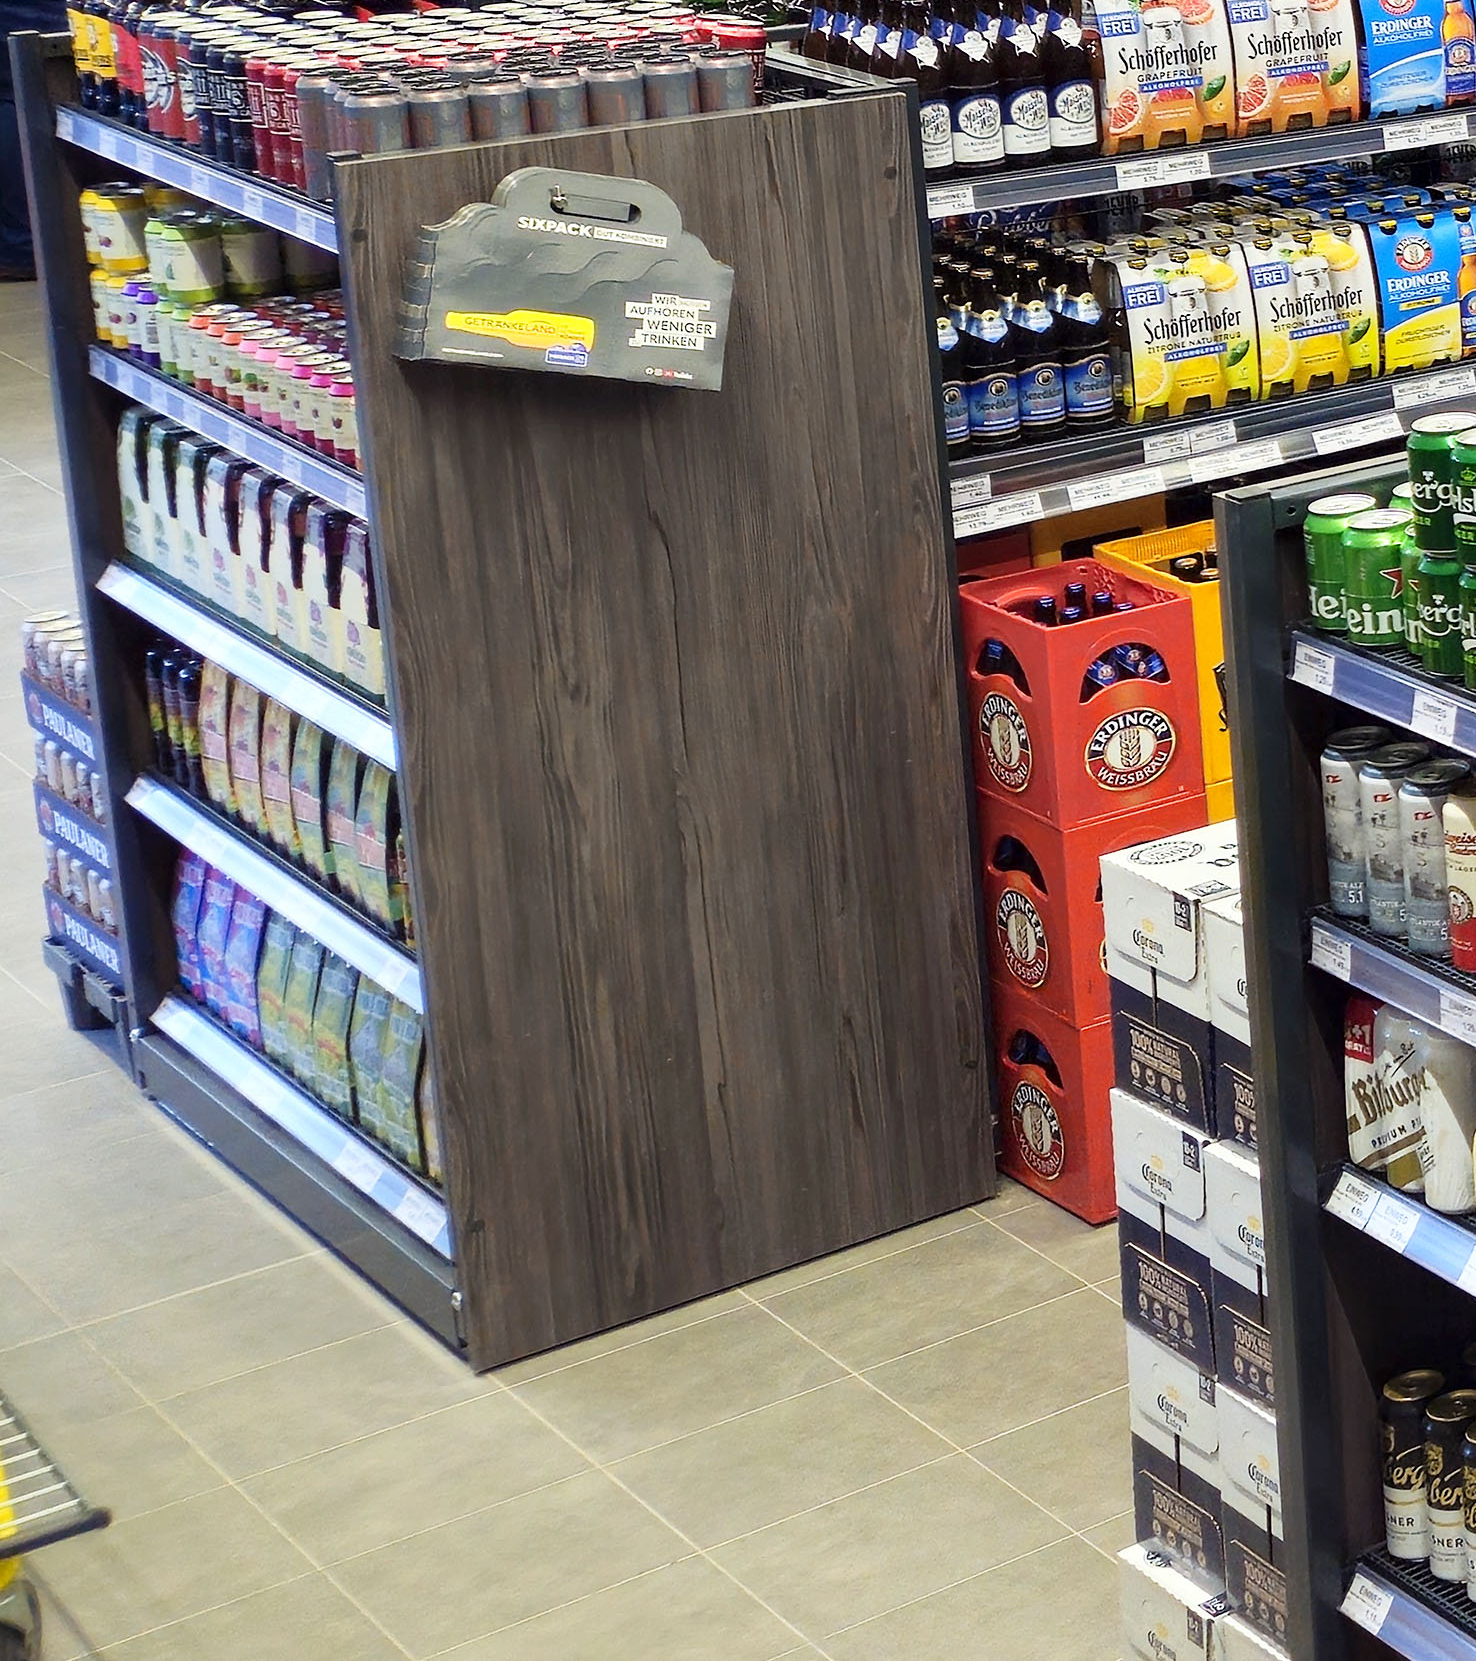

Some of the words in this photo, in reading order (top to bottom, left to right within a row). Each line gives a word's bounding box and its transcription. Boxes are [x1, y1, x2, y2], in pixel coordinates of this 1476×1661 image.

[1231, 4, 1264, 22] FREI
[1103, 19, 1135, 37] FREI
[1371, 14, 1433, 34] ERDINGER
[1247, 27, 1343, 60] Schöfferhofer
[1118, 41, 1219, 76] Schöfferhofer
[1265, 52, 1329, 70] GRAPEFRUIT
[1137, 67, 1203, 85] GRAPEFRUIT
[517, 216, 593, 238] SIXPACK
[615, 230, 665, 247] KOMBINIERT
[1254, 270, 1287, 285] FREI
[1387, 271, 1451, 293] ERDINGER
[653, 293, 677, 305] WIR
[1127, 291, 1161, 306] FREI
[1270, 288, 1363, 323] Schöfferhofer
[464, 315, 556, 334] GETRÄNKELAND
[646, 318, 713, 336] WENIGER
[1144, 308, 1241, 346] Schöfferhofer
[1274, 318, 1312, 333] ZITRONE
[641, 332, 697, 347] TRINKEN
[1147, 341, 1186, 355] ZITRONE
[1088, 709, 1174, 754] ERDINGER
[1095, 753, 1170, 789] WEISSBRÄU
[1132, 928, 1166, 954] Corona
[1141, 1161, 1173, 1192] Corona
